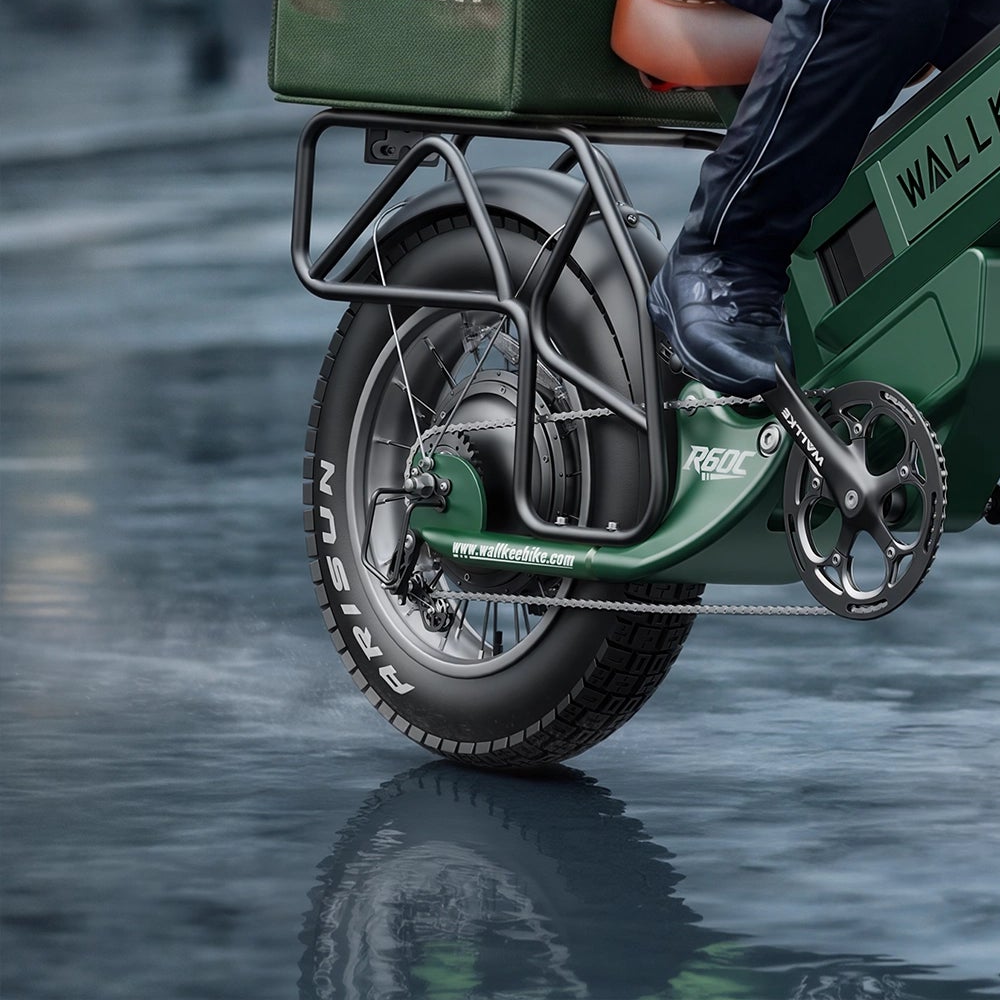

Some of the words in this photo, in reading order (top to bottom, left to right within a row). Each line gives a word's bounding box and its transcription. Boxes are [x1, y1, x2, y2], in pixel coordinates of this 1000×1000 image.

[780, 407, 825, 467] WALLKE
[319, 459, 415, 695] ARISUN
[452, 541, 575, 567] www.wallkeebike.com
